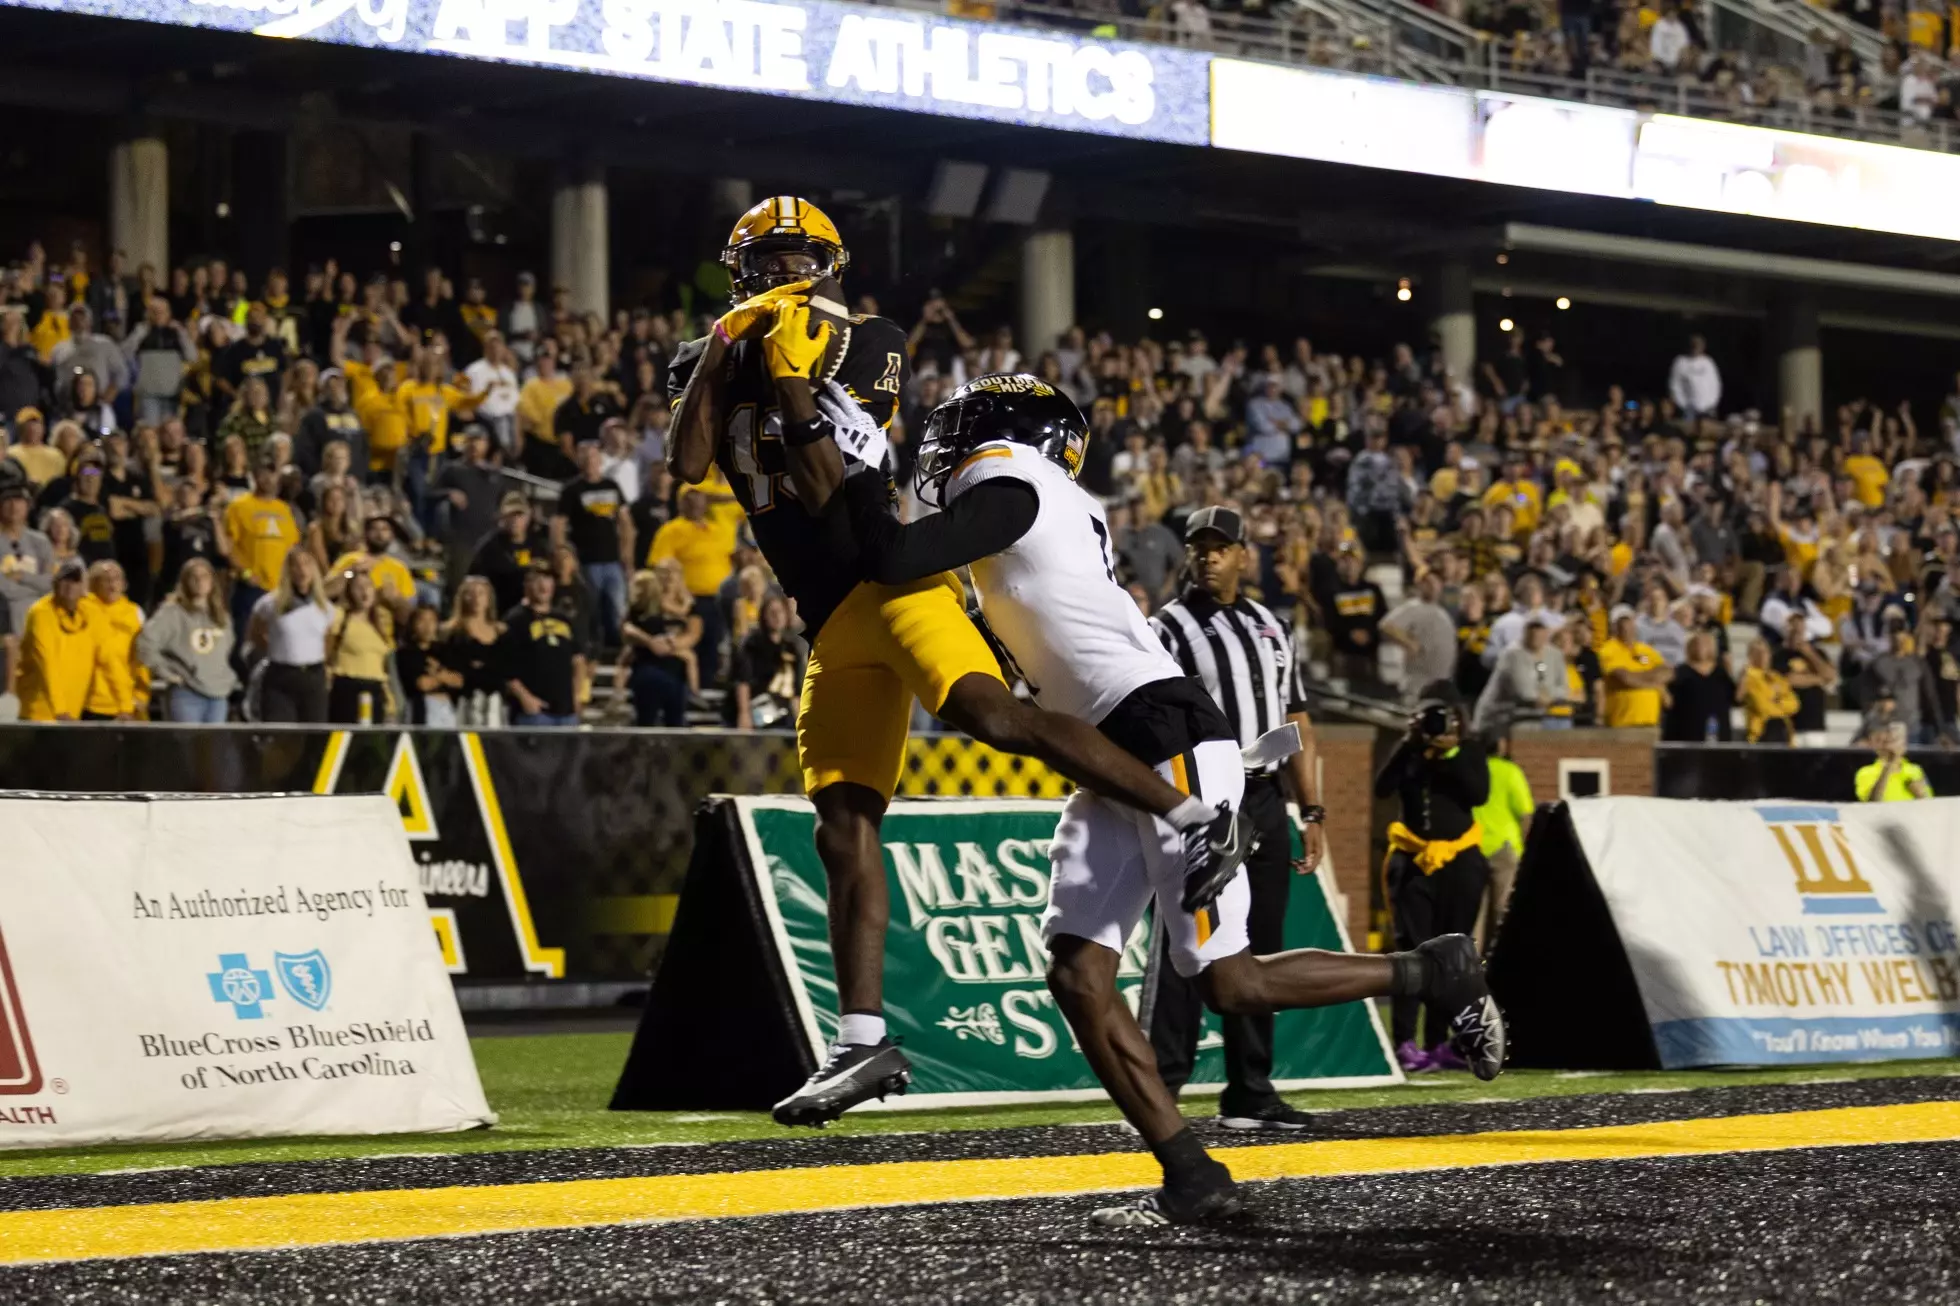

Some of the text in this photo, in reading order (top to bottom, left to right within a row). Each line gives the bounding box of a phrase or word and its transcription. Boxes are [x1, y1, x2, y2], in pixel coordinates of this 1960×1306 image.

[600, 0, 808, 90] STATE
[827, 15, 1155, 124] ATHLETICS
[874, 352, 902, 394] A
[971, 375, 1057, 397] SOUTHERN
[133, 880, 410, 921] An Authorized Agency for
[1749, 925, 1811, 958] LAW
[1859, 957, 1960, 1006] WELB
[138, 1018, 436, 1058] BlueCross BlueShield
[180, 1053, 417, 1091] of North Carolina
